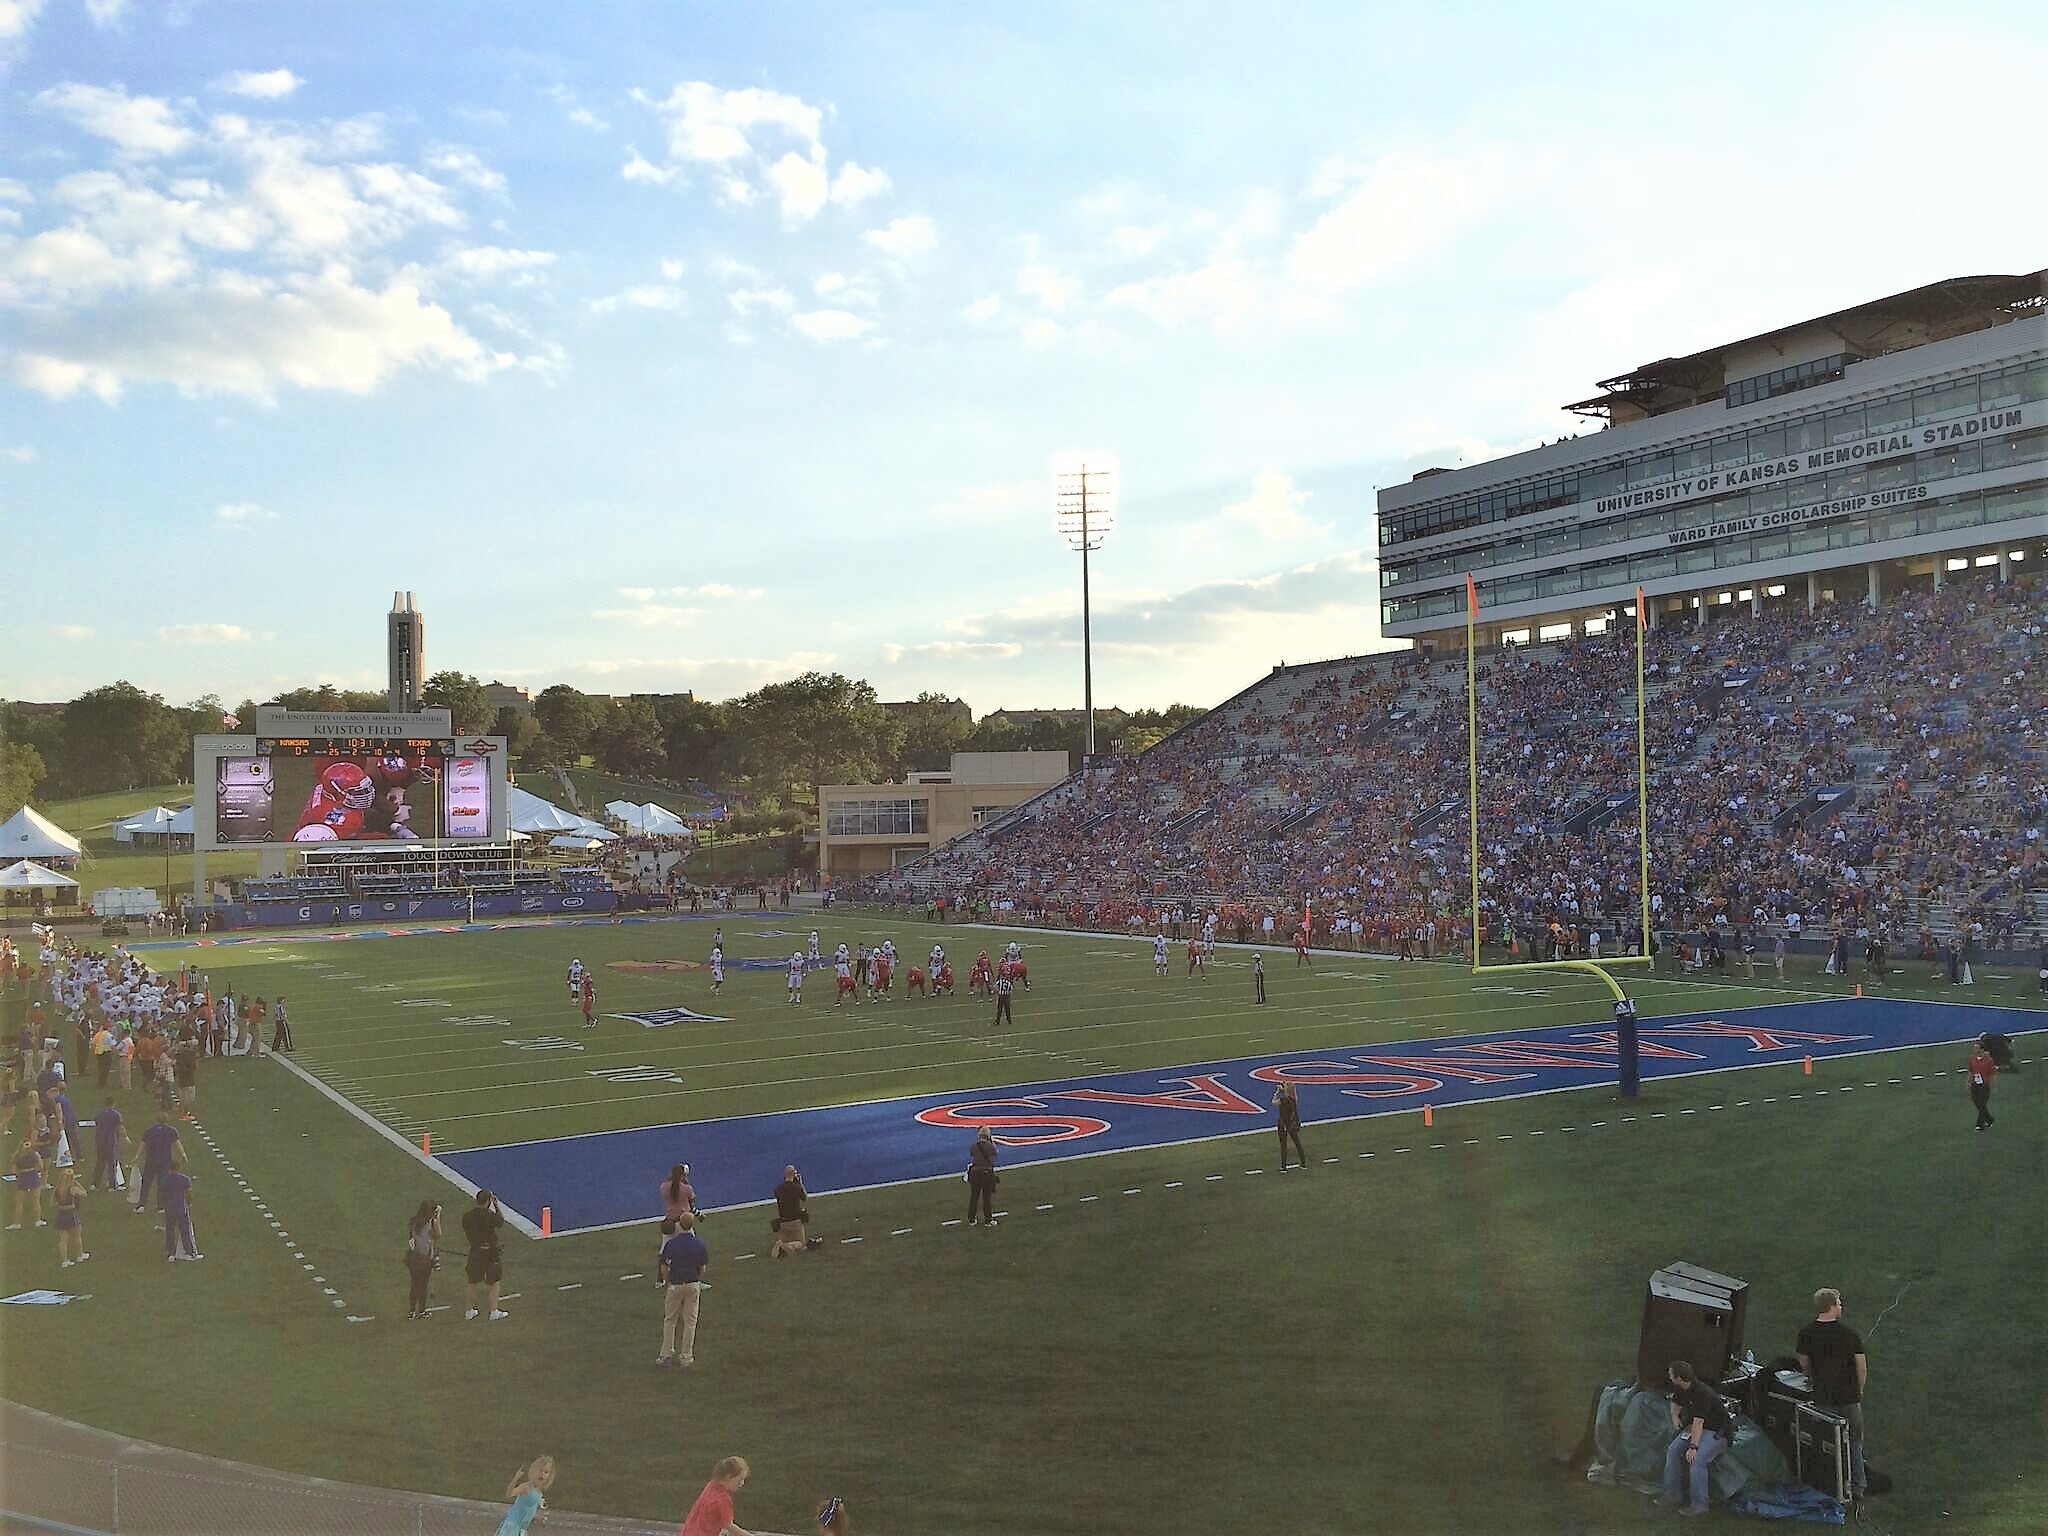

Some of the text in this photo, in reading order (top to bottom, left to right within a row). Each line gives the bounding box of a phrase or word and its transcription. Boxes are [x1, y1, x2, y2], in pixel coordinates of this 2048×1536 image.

[1596, 410, 2023, 514] UNIVERSITY OF KANSAS MEMORIAL STADIUM
[1668, 486, 1928, 545] WARD FAMILY SCHOLARSHIP SUITES
[314, 725, 402, 735] KIVISTO FIELD
[279, 739, 310, 747] KANSAS
[347, 738, 372, 748] 10:31
[407, 739, 432, 747] TEXAS
[328, 748, 340, 756] 25
[352, 748, 358, 756] 2
[374, 748, 383, 756] 10
[416, 747, 426, 756] 16
[476, 850, 503, 859] CLUB
[585, 1064, 676, 1083] 10
[914, 1019, 1875, 1146] KANSAS
